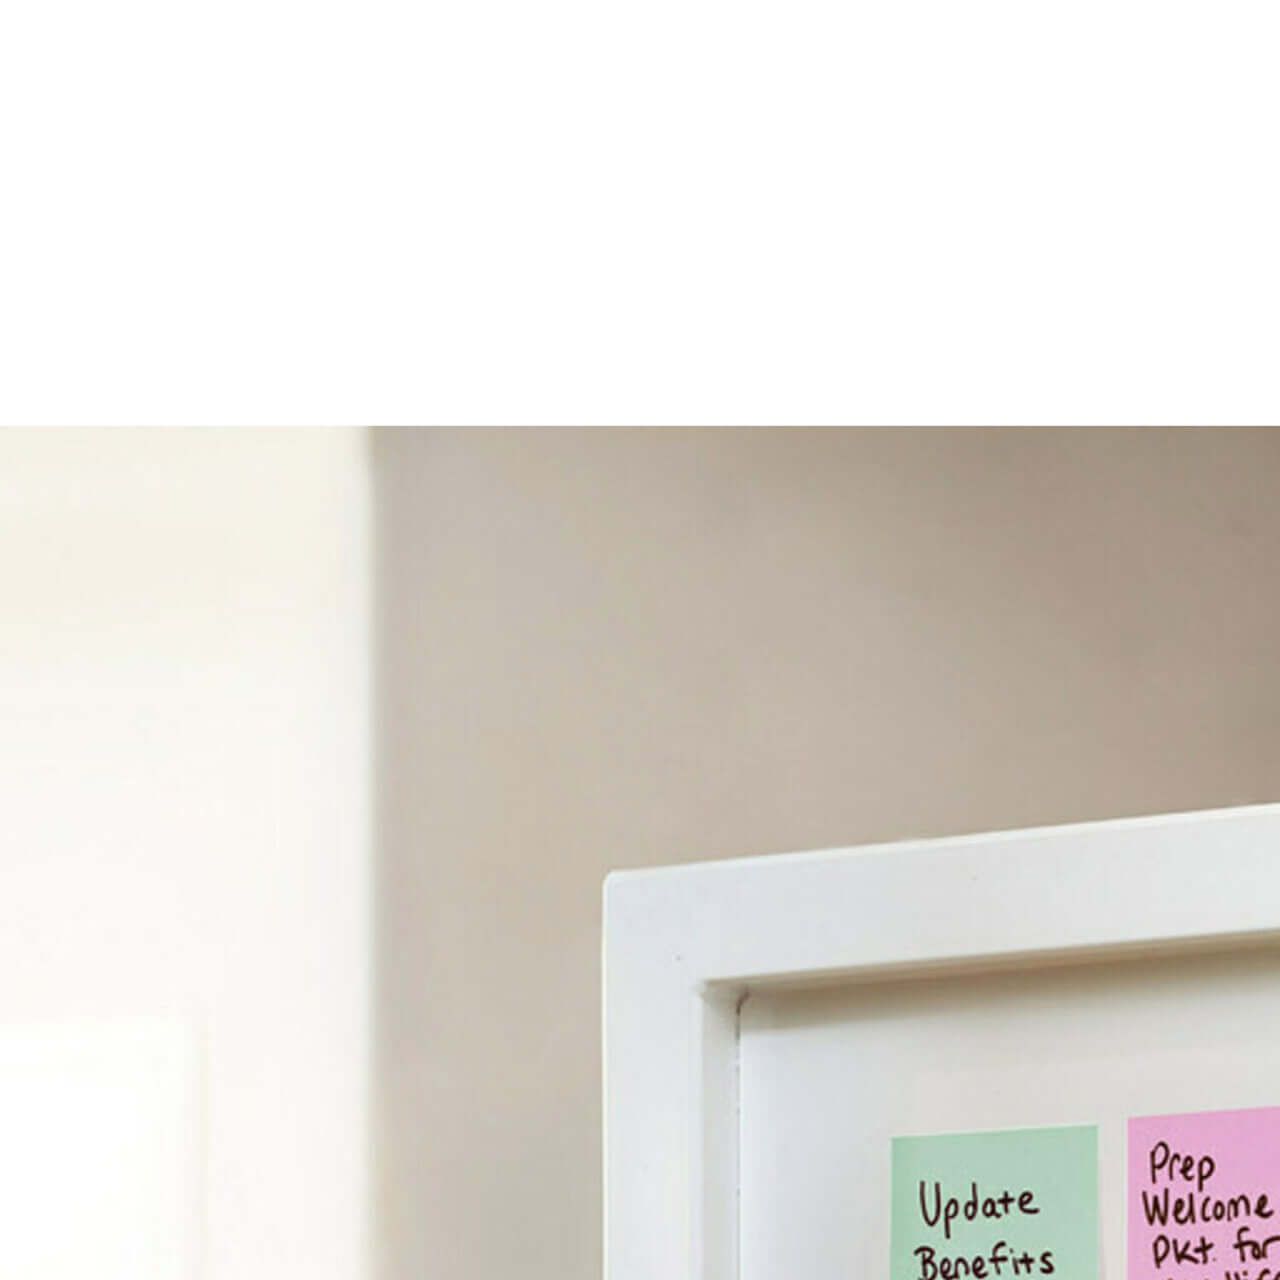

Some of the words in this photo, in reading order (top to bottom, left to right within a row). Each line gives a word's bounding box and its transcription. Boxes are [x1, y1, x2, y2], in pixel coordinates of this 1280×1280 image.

[1149, 1140, 1216, 1193] Prep
[919, 1179, 1041, 1241] Update
[1141, 1186, 1275, 1227] Welcome
